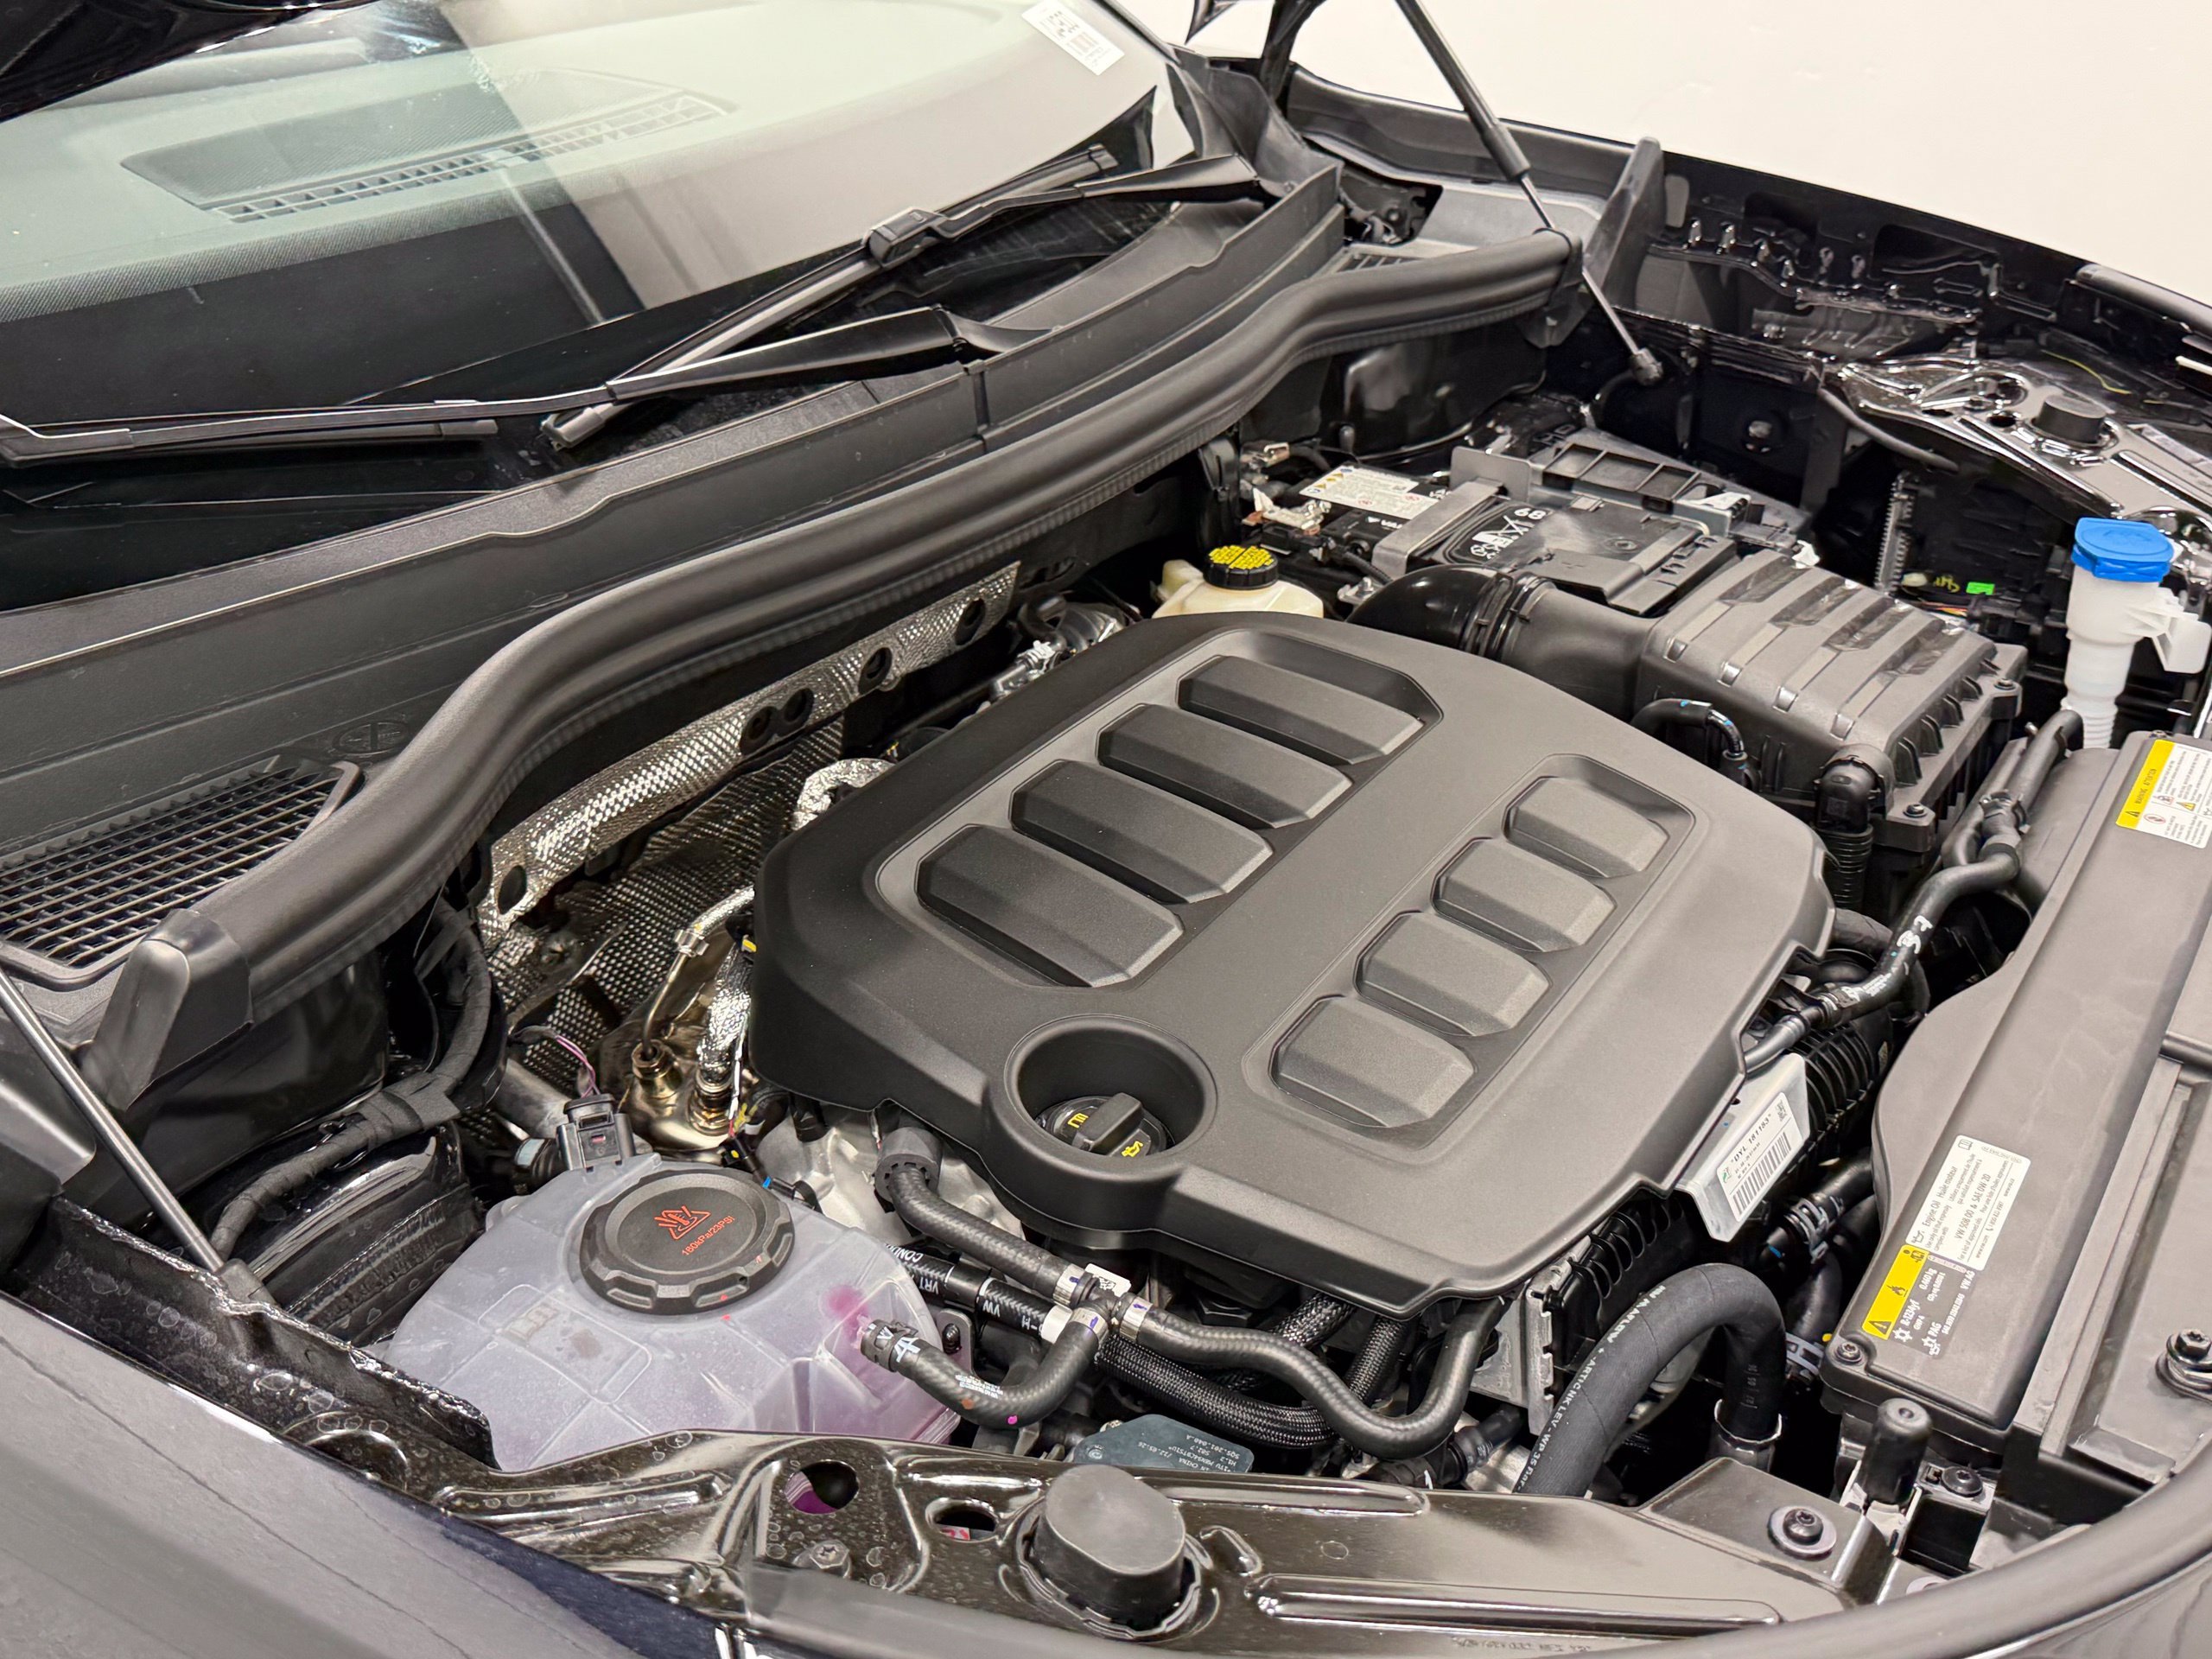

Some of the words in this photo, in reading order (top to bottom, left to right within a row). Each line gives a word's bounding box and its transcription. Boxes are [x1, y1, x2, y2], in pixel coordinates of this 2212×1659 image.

[1922, 1209, 1936, 1226] Engine
[1930, 1199, 1940, 1209] Oil
[1936, 1185, 1948, 1198] Huile
[1944, 1166, 1957, 1184] moteur
[1971, 1192, 1982, 1202] SAE
[1964, 1209, 1974, 1217] 00
[1959, 1217, 1970, 1229] 508
[1955, 1229, 1965, 1238] VW
[1965, 1270, 1974, 1281] AG
[918, 1276, 938, 1294] VRT
[1960, 1278, 1971, 1289] VW
[982, 1300, 1001, 1317] VW
[1900, 1299, 1920, 1325] R-1234yf
[1928, 1322, 1941, 1337] PAG
